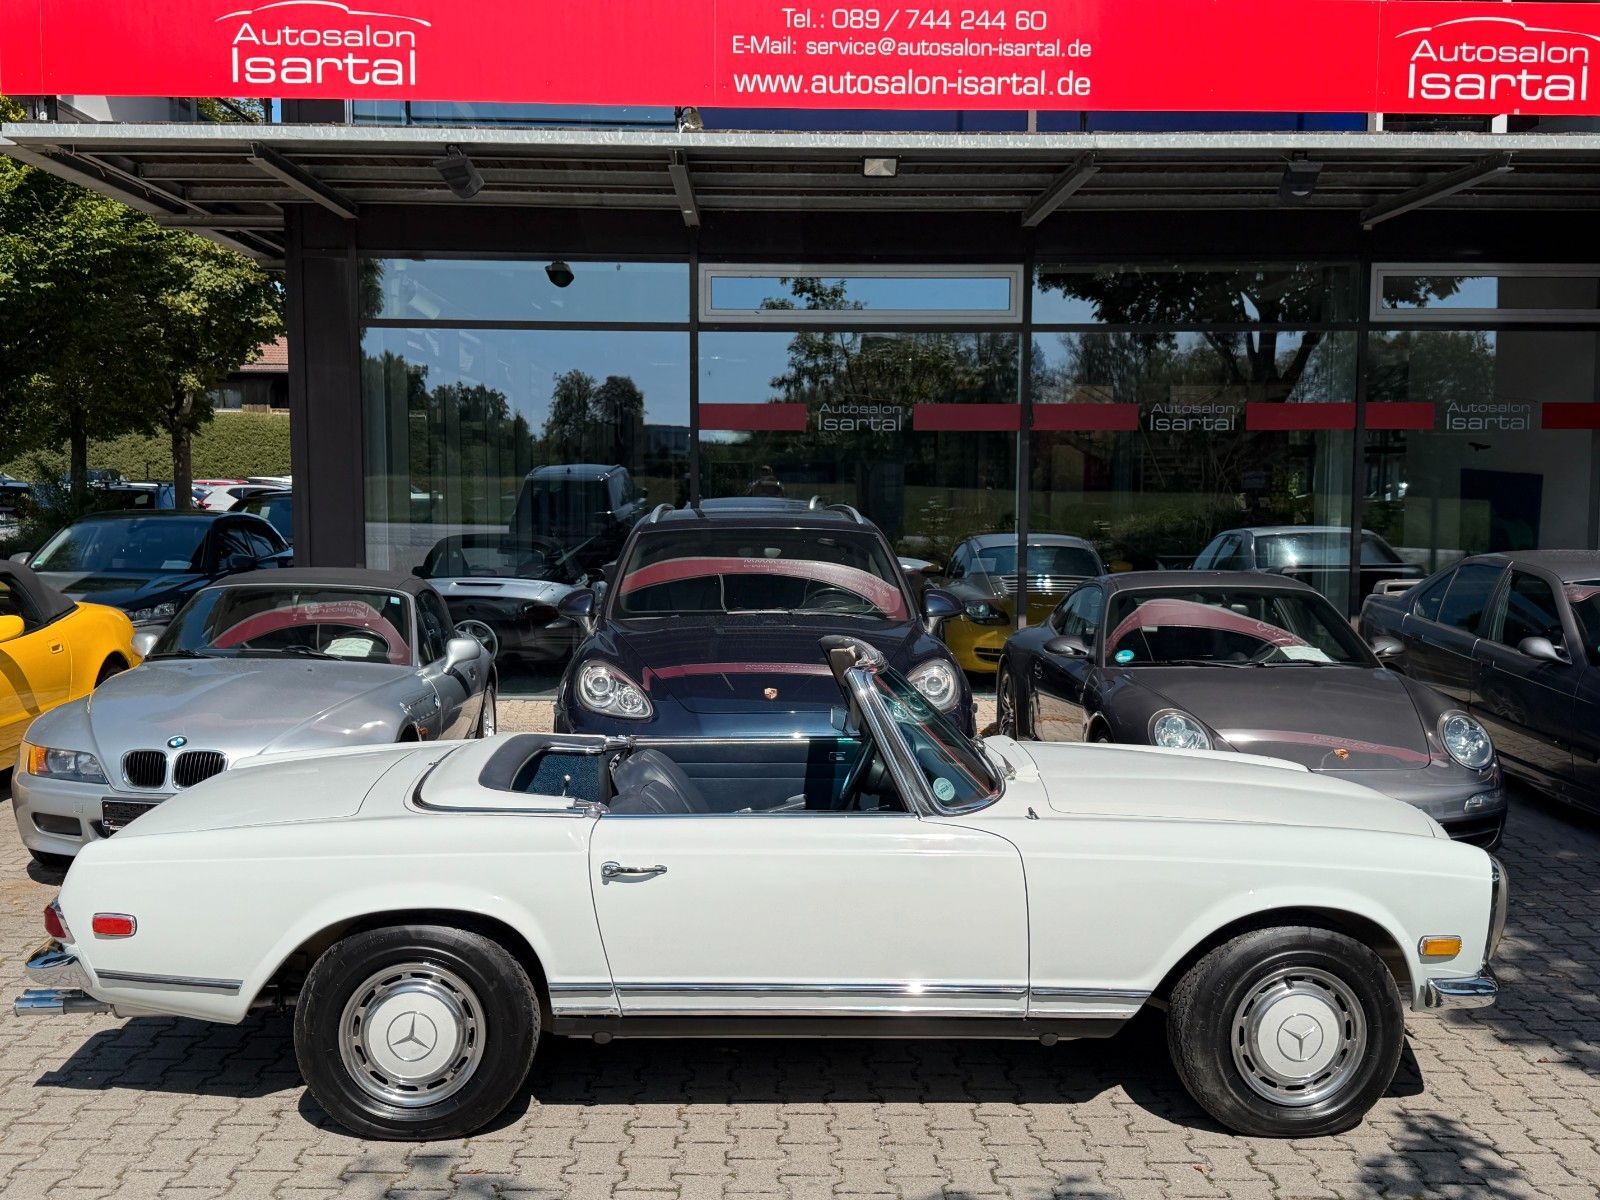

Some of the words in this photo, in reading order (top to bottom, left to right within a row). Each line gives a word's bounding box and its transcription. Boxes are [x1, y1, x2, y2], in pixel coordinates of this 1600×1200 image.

[782, 8, 825, 29] Tel.:
[831, 9, 880, 30] 089
[906, 10, 952, 30] 744
[960, 10, 1007, 30] 244
[1016, 11, 1047, 31] 60
[232, 23, 416, 48] Autosalon
[732, 36, 797, 55] E-Mail:
[806, 37, 1092, 58] service@autosalon-isartal.de
[1410, 39, 1589, 64] Autosalon
[232, 48, 416, 86] Isartal
[734, 69, 1091, 96] www.autosalon-isartal.de
[1408, 63, 1588, 101] Isartal
[819, 403, 902, 414] Autosalon
[1151, 403, 1236, 414] Autosalon
[1446, 402, 1531, 413] Autosalon
[818, 414, 902, 431] Isartal
[1150, 414, 1235, 431] Isartal
[1446, 414, 1530, 430] Isartal
